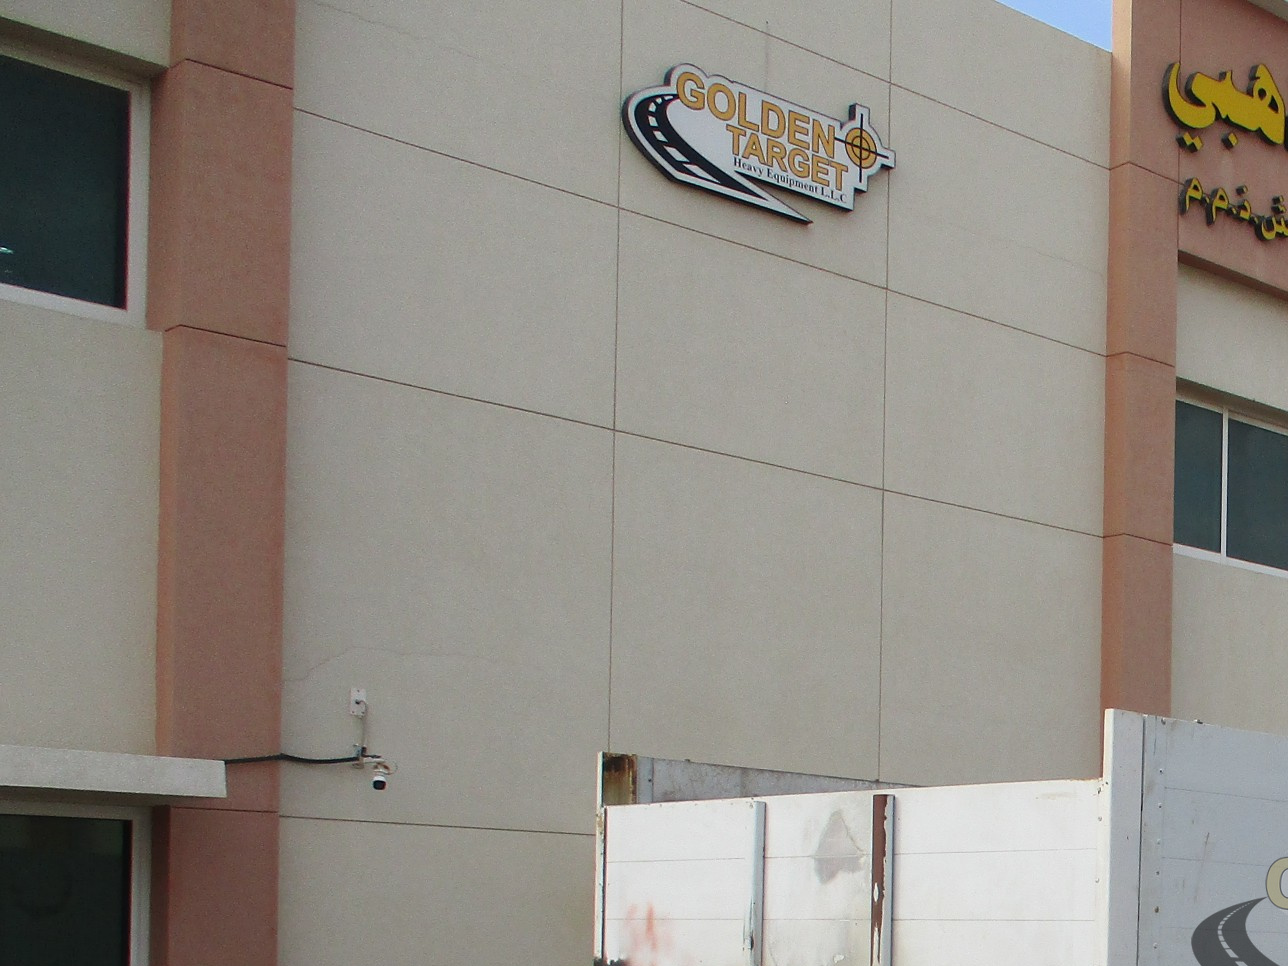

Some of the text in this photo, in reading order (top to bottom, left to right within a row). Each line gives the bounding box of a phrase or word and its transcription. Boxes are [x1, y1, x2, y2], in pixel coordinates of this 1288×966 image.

[676, 71, 836, 159] GOLDEN
[726, 123, 849, 192] TARGET
[733, 157, 764, 177] Heavy
[767, 168, 818, 193] Equipment
